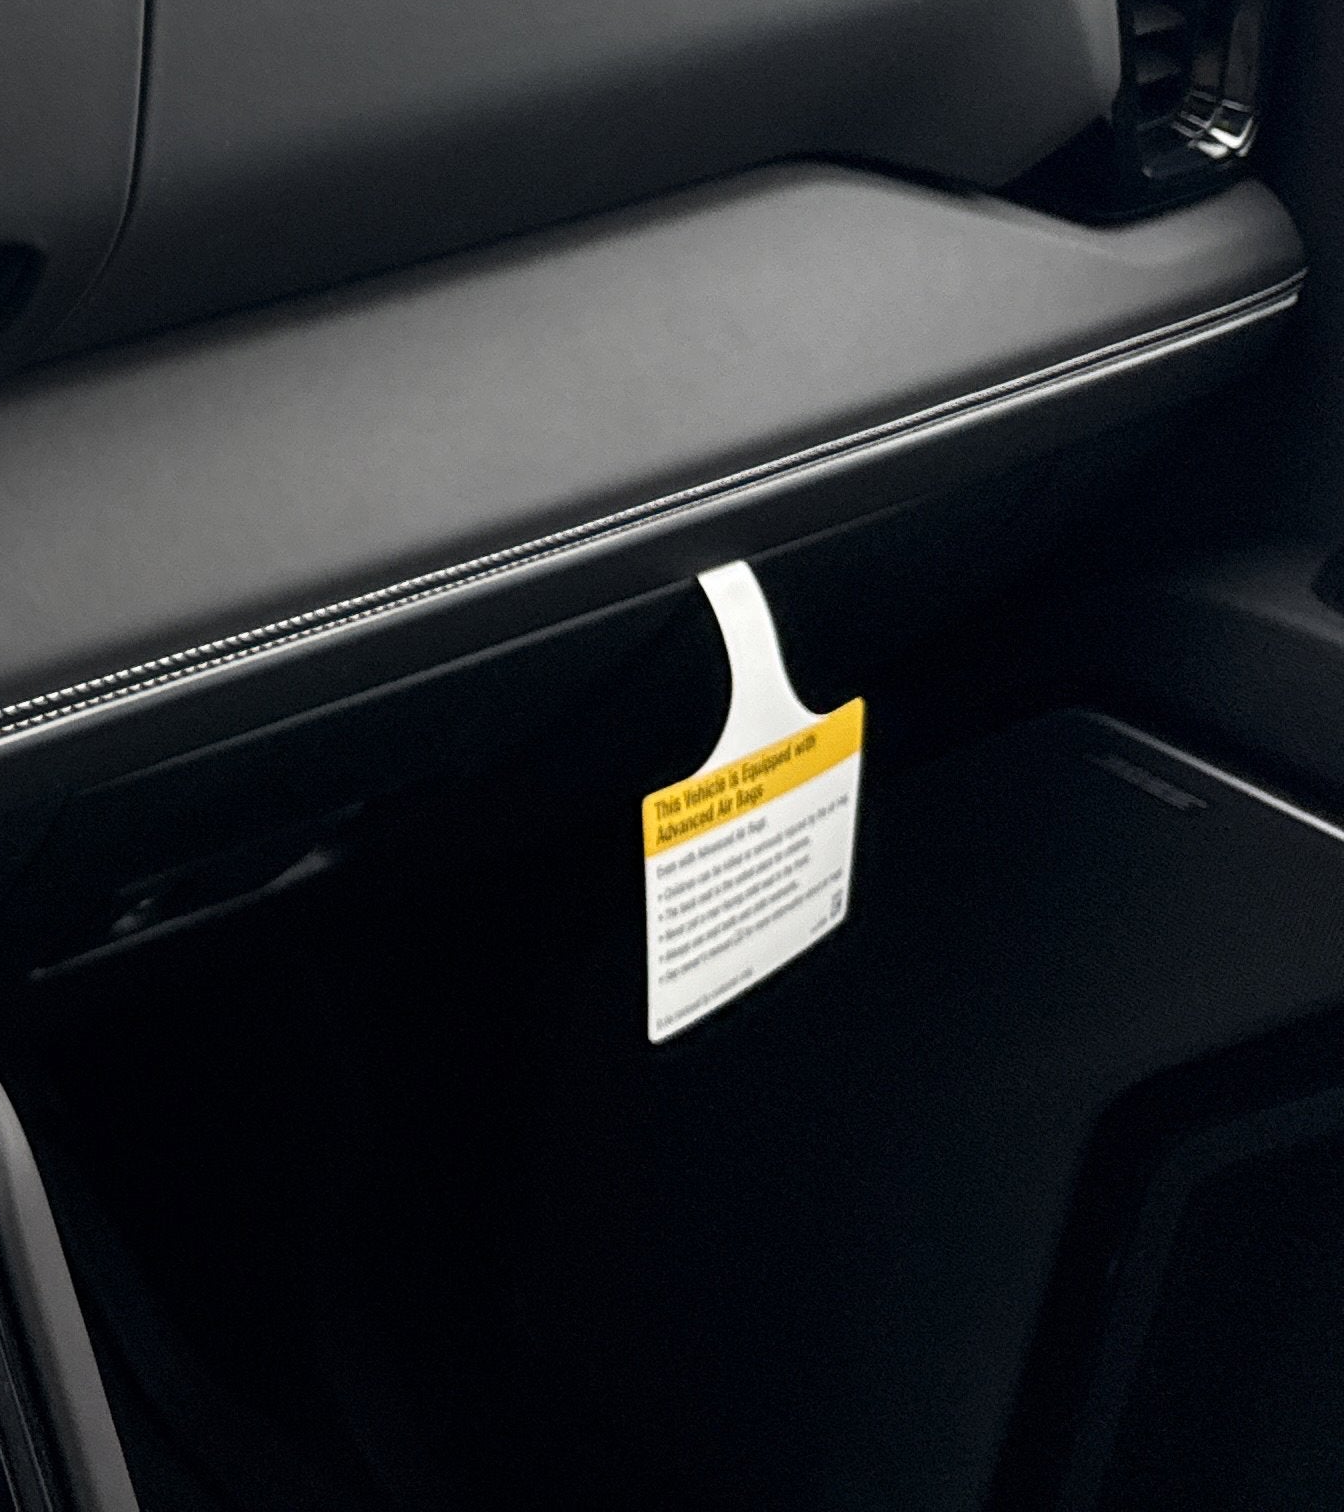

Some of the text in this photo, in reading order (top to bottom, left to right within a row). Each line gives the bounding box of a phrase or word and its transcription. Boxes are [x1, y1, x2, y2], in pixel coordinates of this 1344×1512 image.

[653, 795, 682, 821] This
[683, 774, 726, 809] Vehicle
[728, 767, 740, 789] is
[655, 800, 715, 846] Advanced
